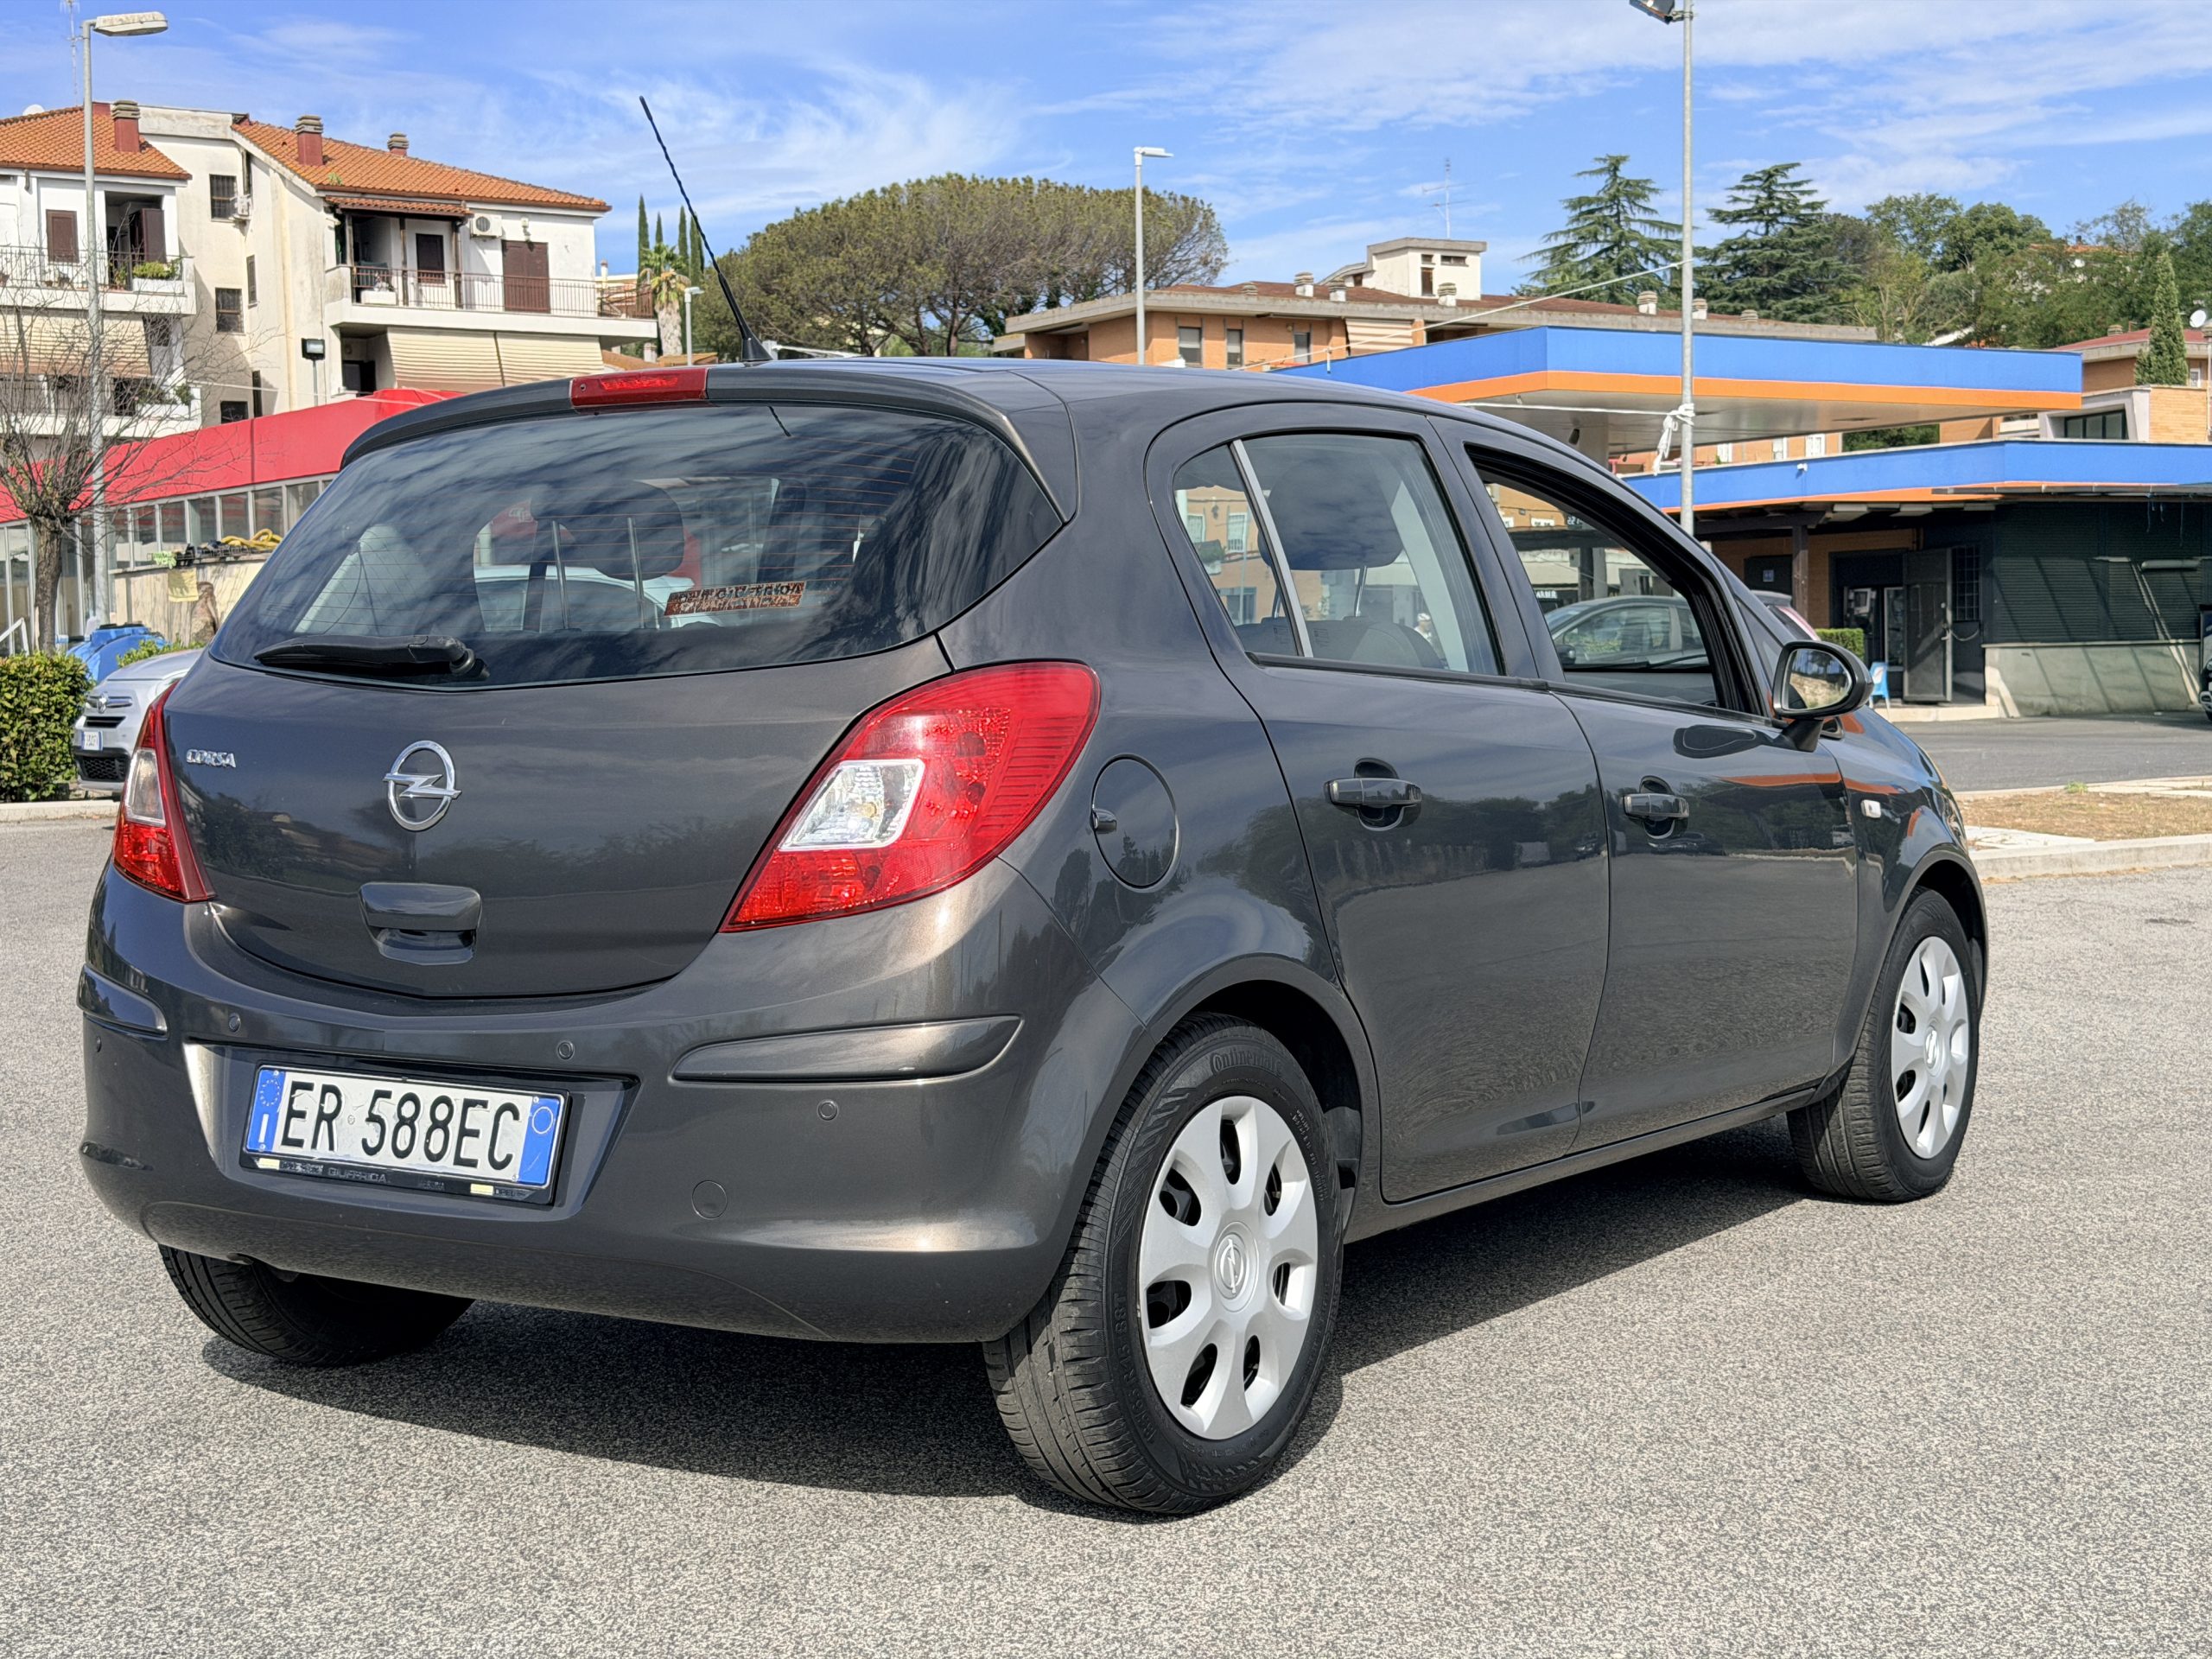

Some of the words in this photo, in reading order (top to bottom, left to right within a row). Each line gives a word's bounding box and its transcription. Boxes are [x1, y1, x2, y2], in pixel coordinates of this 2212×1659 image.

[186, 748, 236, 768] CORSA
[281, 1081, 343, 1151] ER
[361, 1090, 520, 1170] 588EC
